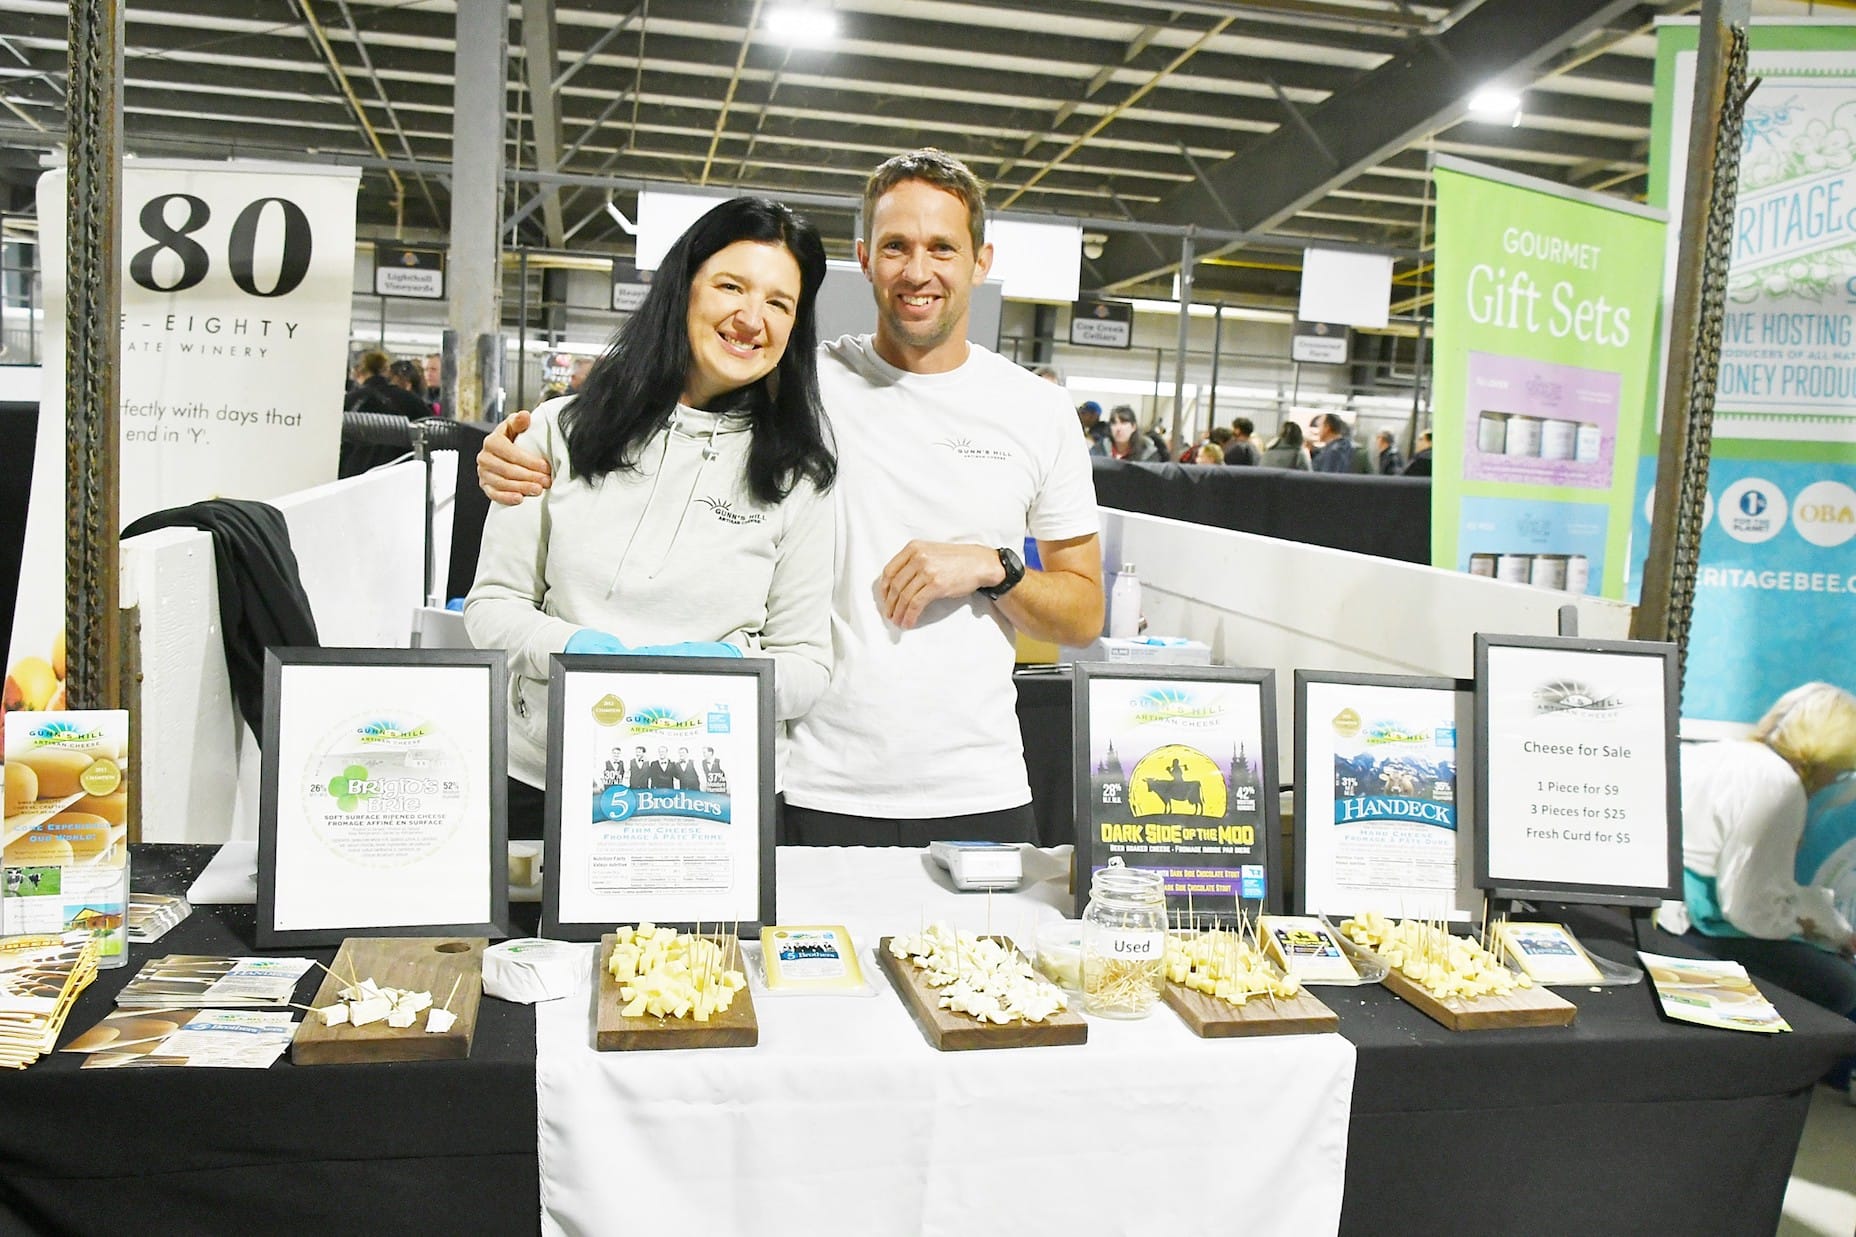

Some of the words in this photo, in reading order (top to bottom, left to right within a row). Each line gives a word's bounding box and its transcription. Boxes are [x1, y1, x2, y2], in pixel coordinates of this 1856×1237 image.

[1504, 227, 1601, 271] GOURMET
[1468, 264, 1541, 333] Gift
[1550, 281, 1631, 348] Sets
[1762, 313, 1851, 346] HOSTING
[121, 341, 163, 353] ATE
[180, 343, 269, 358] WINERY
[172, 403, 209, 420] with
[216, 405, 258, 426] days
[266, 408, 302, 427] that
[126, 426, 158, 442] end
[164, 427, 179, 442] in
[715, 508, 746, 520] GUNN'S
[1193, 706, 1225, 715] HILL
[626, 716, 670, 727] GUNN'S
[676, 719, 703, 729] HILL
[29, 731, 73, 739] GUNN'S
[79, 732, 104, 740] HILL
[1524, 741, 1574, 755] Cheese
[1579, 744, 1599, 756] for
[1603, 745, 1631, 759] Sale
[1103, 783, 1122, 797] 28%
[1236, 787, 1256, 800] 42%
[1538, 782, 1543, 792] 1
[1548, 782, 1580, 794] Piece
[1584, 783, 1600, 794] for
[1605, 784, 1619, 796] $9
[609, 789, 629, 818] 5
[638, 791, 722, 816] Brothers
[1343, 797, 1451, 824] HANDECK
[1531, 804, 1538, 815] 3
[1542, 805, 1579, 817] Pieces
[1583, 807, 1600, 818] for
[1604, 808, 1626, 820] $25
[1101, 823, 1144, 844] DARK
[1145, 824, 1183, 845] SIDE
[1198, 829, 1218, 842] THE
[1218, 825, 1255, 846] MOO
[1393, 831, 1433, 839] CHEESE
[1527, 828, 1559, 840] Fresh
[1563, 830, 1591, 842] Curd
[1595, 831, 1613, 843] for
[1617, 832, 1631, 845] $5
[1170, 870, 1184, 878] DARK
[1115, 940, 1150, 953] Used
